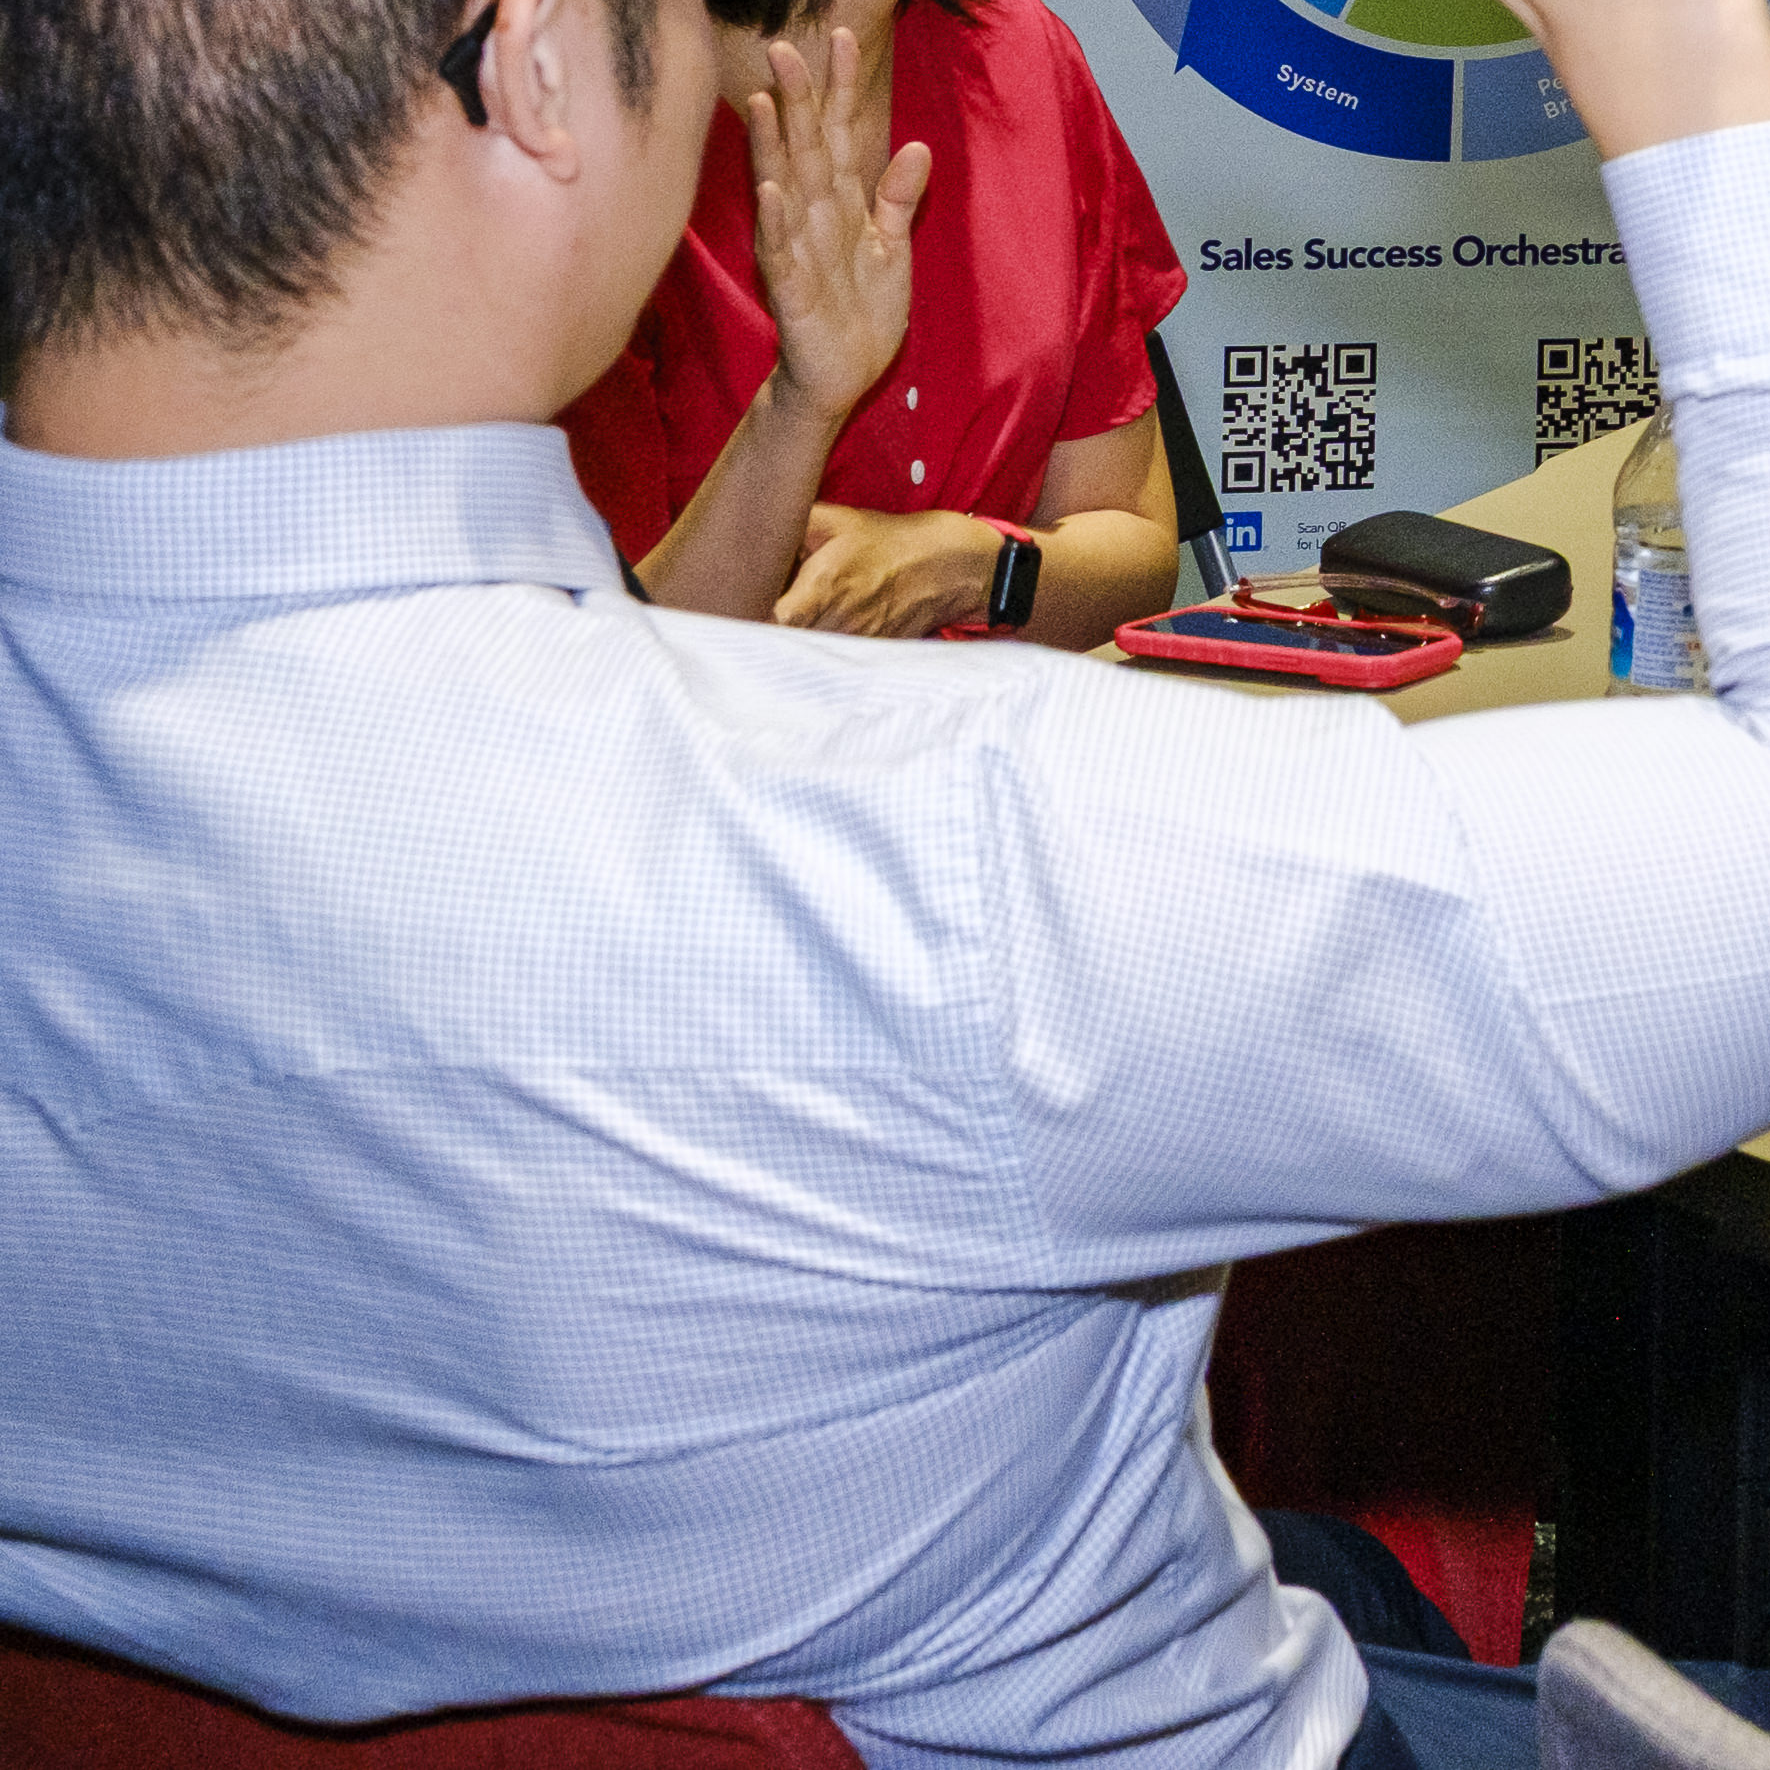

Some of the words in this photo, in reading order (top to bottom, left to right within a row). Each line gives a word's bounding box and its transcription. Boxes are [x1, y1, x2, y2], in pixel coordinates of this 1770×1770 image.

[1276, 64, 1359, 110] System
[1200, 237, 1293, 272] Sales
[1304, 236, 1442, 270] Success
[1452, 233, 1627, 267] Orchestra
[1297, 523, 1324, 534] Scan
[1297, 539, 1311, 550] for
